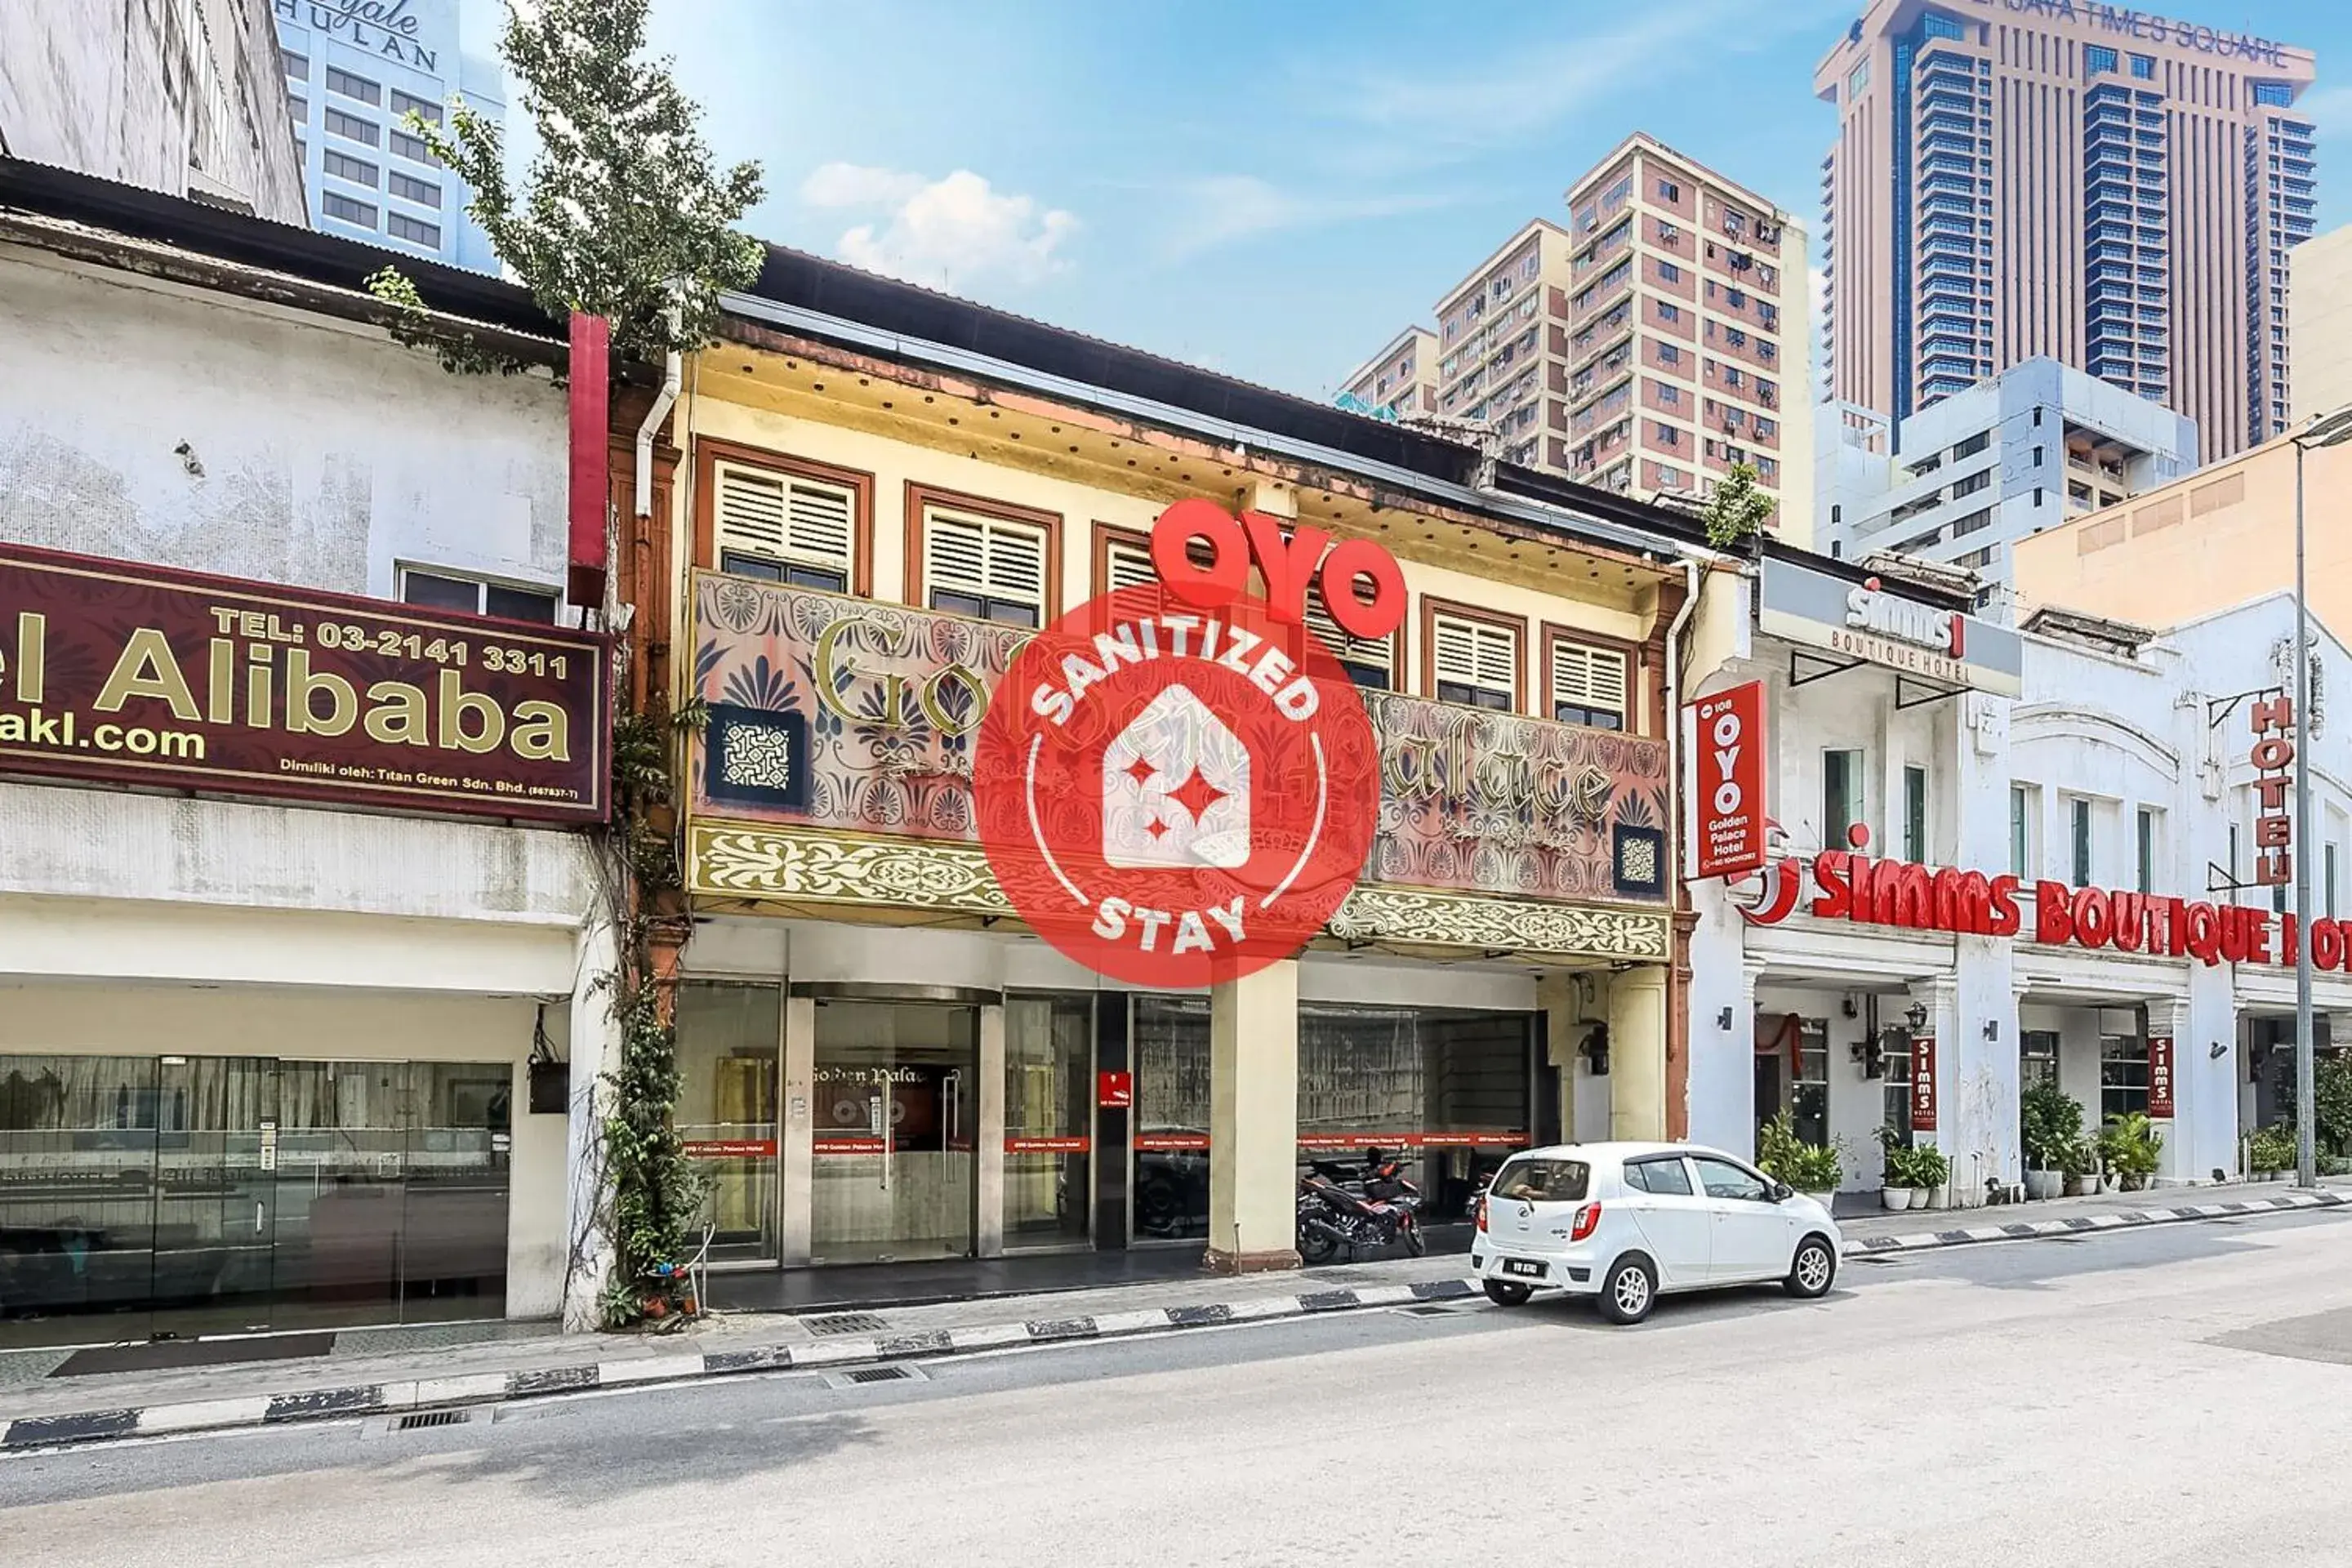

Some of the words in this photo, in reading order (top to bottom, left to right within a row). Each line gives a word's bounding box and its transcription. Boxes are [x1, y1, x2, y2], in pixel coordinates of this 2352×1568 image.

[2087, 2, 2167, 42] TIMES
[2175, 21, 2289, 69] SQUARE
[1150, 498, 1407, 639] OYO
[210, 607, 304, 644] TEL:
[317, 622, 468, 666] 03-2141
[483, 646, 568, 679] 3311
[1832, 630, 1915, 667] BOUTIQUE
[1923, 656, 1971, 683] HOTEL
[92, 627, 571, 762] Alibaba
[339, 767, 376, 780] oleh:
[377, 768, 412, 783] Titan
[416, 773, 458, 788] Green
[462, 777, 492, 792] Sdn.
[496, 780, 527, 795] Bhd.
[1713, 713, 1741, 815] OYO
[2252, 698, 2294, 885] HOTEL
[1708, 816, 1748, 831] Golden
[1710, 830, 1746, 844] Palace
[1713, 840, 1743, 857] Hotel
[2037, 880, 2272, 967] BOUTIQUE
